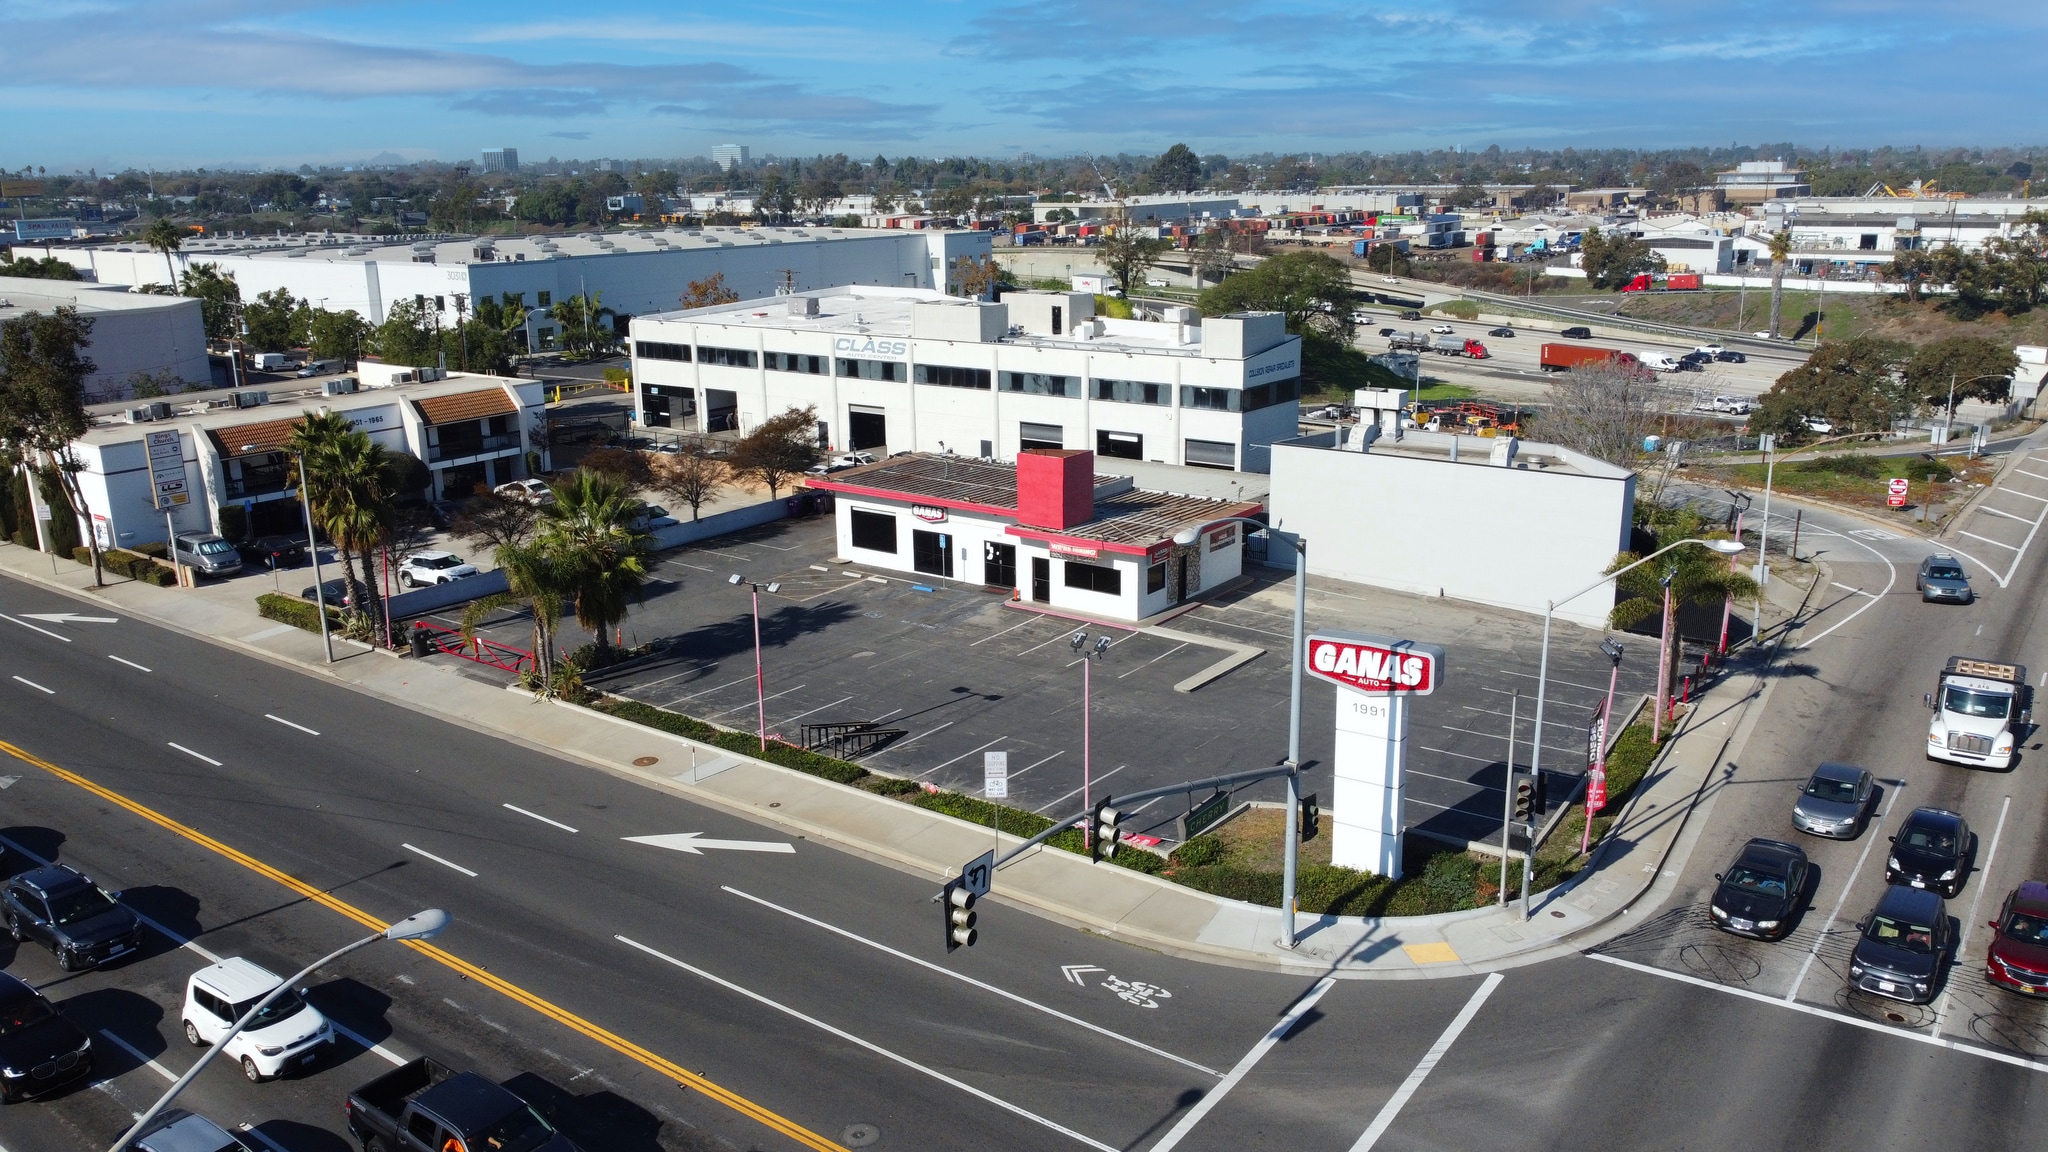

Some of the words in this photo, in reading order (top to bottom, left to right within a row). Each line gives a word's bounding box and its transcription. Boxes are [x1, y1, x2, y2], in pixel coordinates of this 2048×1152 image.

[836, 338, 906, 355] CLASS
[368, 416, 384, 424] 1965
[914, 506, 942, 518] GANAS
[1314, 644, 1423, 686] GANAS
[1358, 678, 1380, 686] AUTO
[1352, 702, 1386, 717] 1991
[1190, 802, 1224, 831] CHERRY
